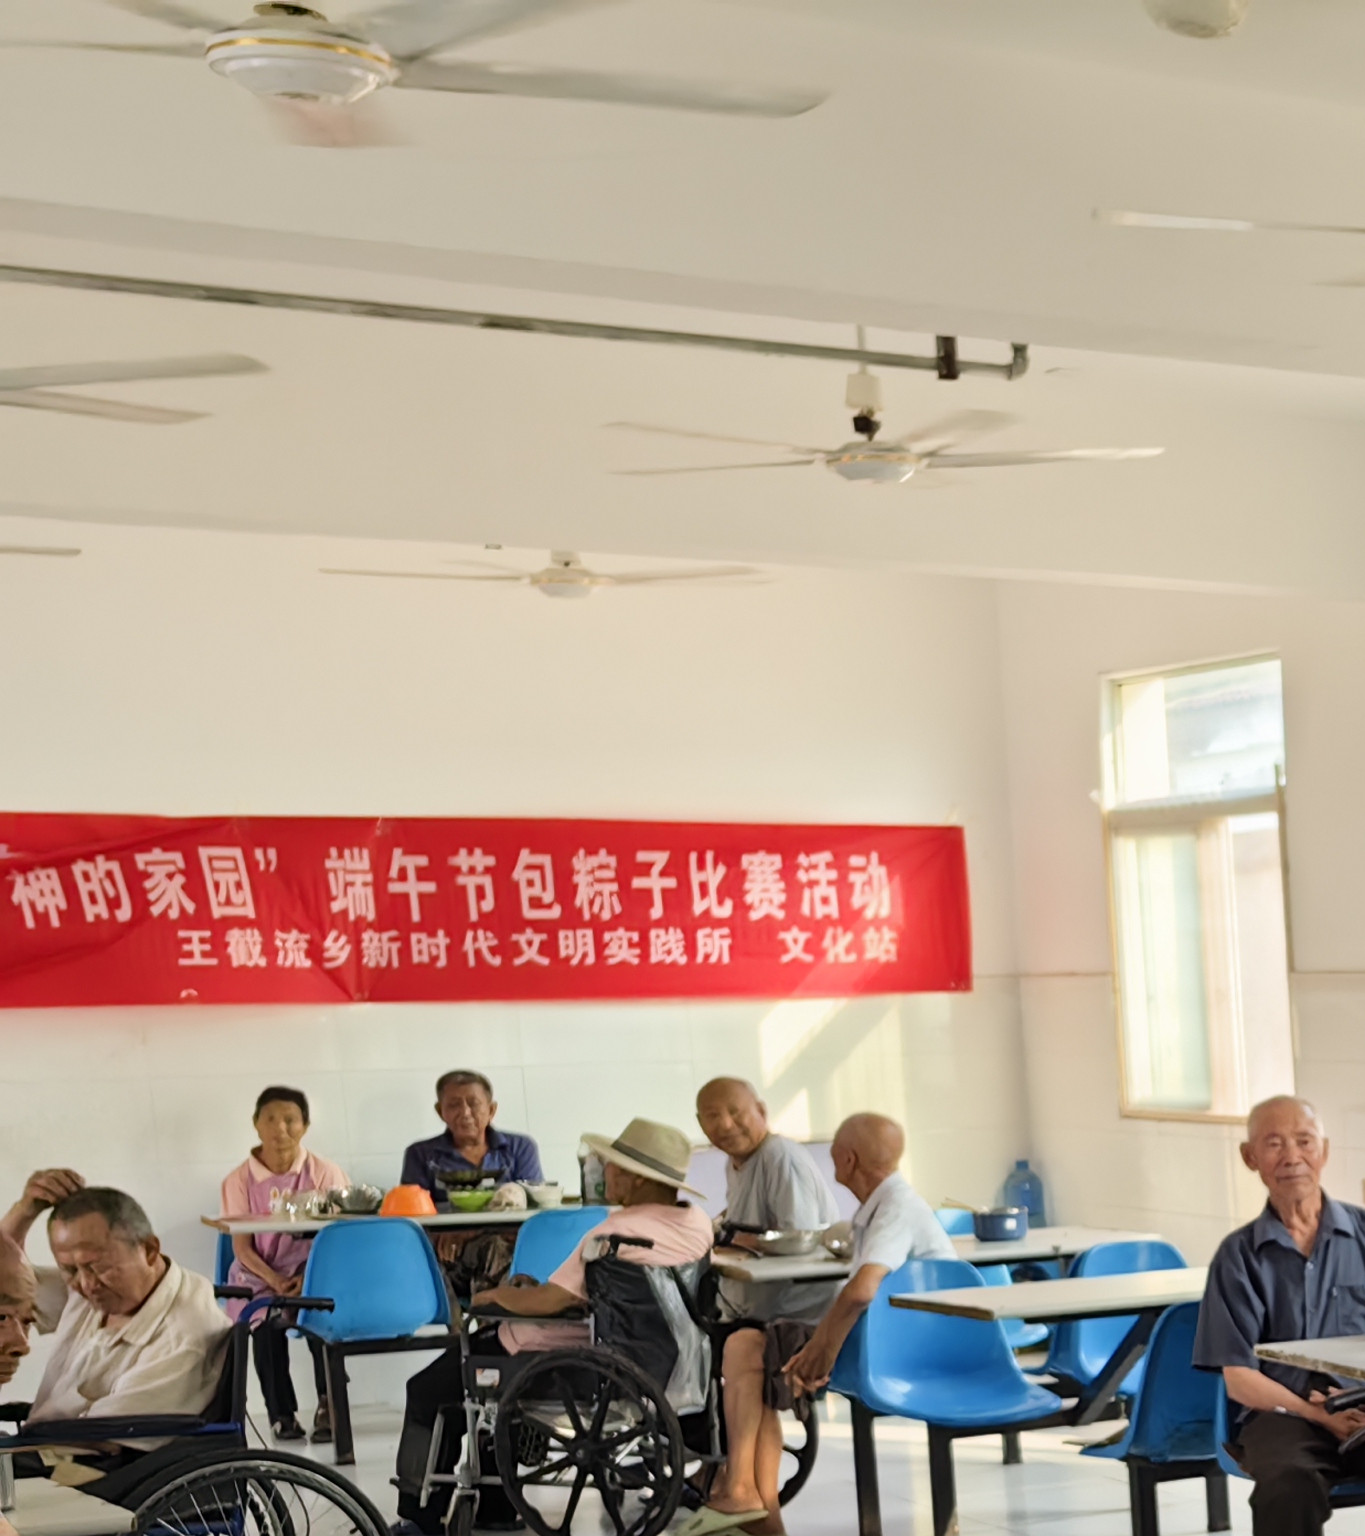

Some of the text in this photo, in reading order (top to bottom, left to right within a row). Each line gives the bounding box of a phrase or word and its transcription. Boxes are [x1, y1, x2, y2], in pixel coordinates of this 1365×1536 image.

[324, 847, 893, 923] 端午节包粽子比赛活动
[177, 927, 900, 970] 王截流乡新时代文明实践所 文化站
